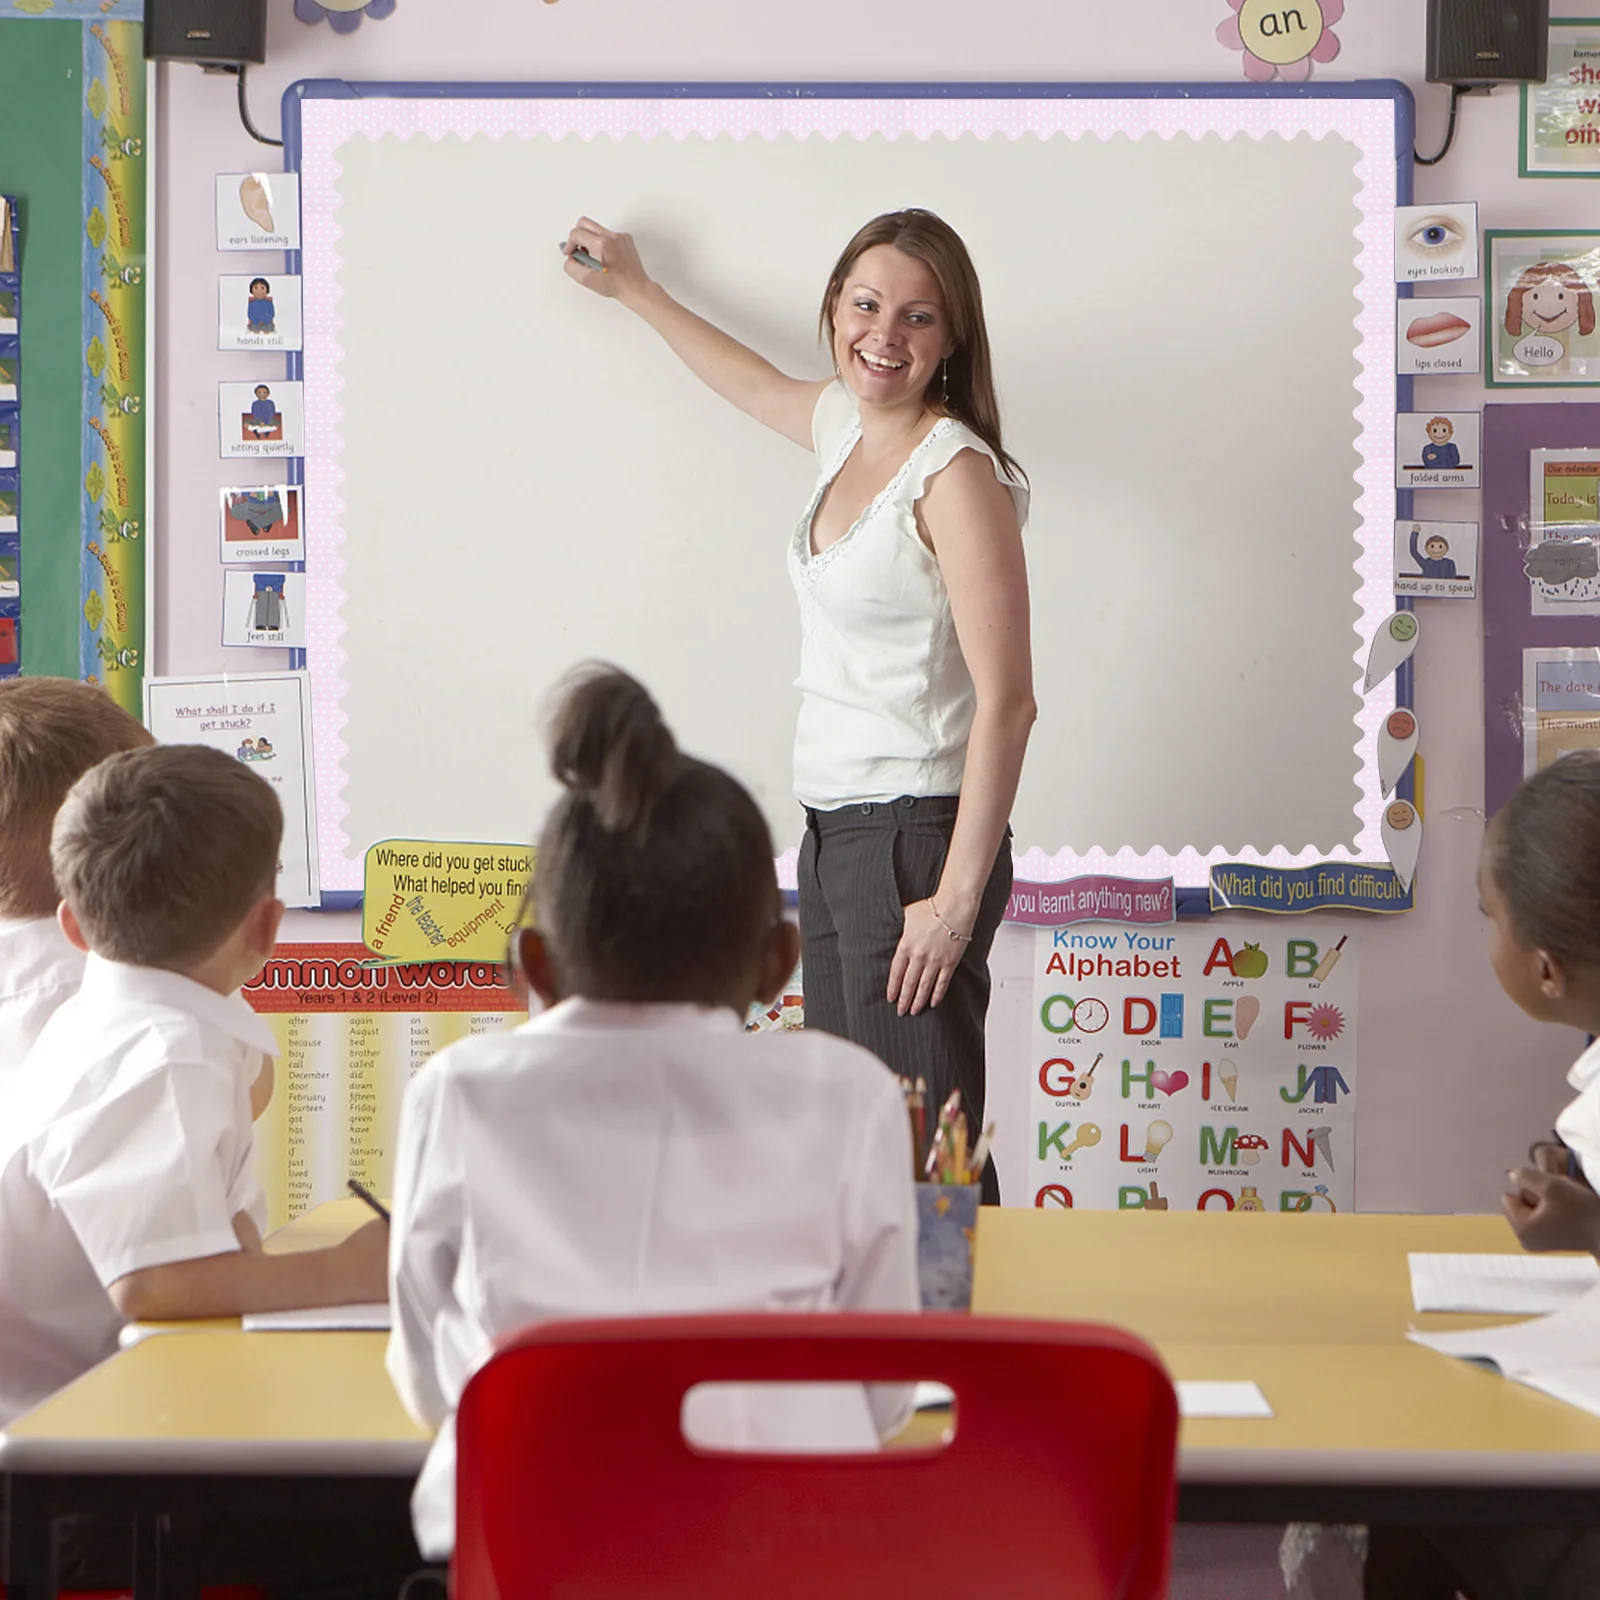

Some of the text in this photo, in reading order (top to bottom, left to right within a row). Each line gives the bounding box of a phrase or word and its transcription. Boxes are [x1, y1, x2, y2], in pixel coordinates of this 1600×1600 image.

[1260, 9, 1307, 37] an
[251, 235, 289, 247] listening
[1407, 265, 1465, 279] eyes looking
[237, 336, 284, 346] hands still
[1524, 346, 1554, 358] Hello
[1415, 358, 1463, 370] lips closed
[231, 441, 295, 456] sitting quietly
[1409, 473, 1440, 486] folded
[1546, 492, 1596, 509] Today is
[236, 546, 290, 559] crossed legs
[1394, 581, 1474, 595] hand up to speak
[246, 631, 284, 644] feet still
[1539, 680, 1593, 693] The date
[175, 702, 276, 717] What shall I do if I
[199, 718, 252, 732] get stuck?
[376, 849, 419, 868] Where
[422, 851, 442, 869] did
[446, 855, 470, 874] you
[473, 855, 495, 875] get
[393, 874, 428, 893] What
[431, 876, 476, 898] helped
[478, 881, 503, 899] you
[1216, 872, 1257, 897] What
[1260, 874, 1283, 899] did
[1286, 878, 1314, 906] you
[1317, 872, 1345, 896] find
[1349, 873, 1409, 900] difficult
[1012, 886, 1170, 917] you learnt anything new?
[371, 893, 405, 950] a friend
[405, 894, 447, 948] the teacher
[446, 898, 506, 948] equipment
[1053, 930, 1176, 951] Know Your
[1203, 937, 1239, 978] A
[1286, 940, 1320, 979] B
[1045, 952, 1182, 982] Alphabet
[296, 991, 335, 1005] Years
[340, 991, 346, 1004] 1
[352, 991, 362, 1004] &
[366, 991, 375, 1004] 2
[380, 991, 421, 1006] (Level
[425, 991, 438, 1005] 2)
[1040, 994, 1076, 1034] C
[1123, 997, 1157, 1035] D
[1203, 999, 1234, 1038] E
[288, 1016, 308, 1027] after
[349, 1017, 374, 1028] again
[470, 1016, 504, 1025] another
[1284, 1001, 1313, 1040] F
[288, 1029, 298, 1037] as
[349, 1027, 380, 1038] August
[410, 1027, 431, 1036] back
[288, 1039, 322, 1047] because
[349, 1038, 366, 1047] bed
[410, 1038, 431, 1046] been
[1141, 1039, 1162, 1047] DOOR
[288, 1050, 305, 1059] boy
[349, 1049, 381, 1058] brother
[288, 1060, 304, 1069] call
[349, 1059, 375, 1069] called
[288, 1071, 330, 1079] December
[349, 1070, 364, 1079] did
[1039, 1058, 1076, 1098] G
[1121, 1059, 1155, 1100] H
[288, 1082, 309, 1091] door
[349, 1081, 374, 1090] down
[1279, 1064, 1307, 1104] J
[288, 1092, 326, 1102] February
[349, 1091, 376, 1103] fifteen
[288, 1103, 324, 1114] fourteen
[349, 1103, 376, 1114] Friday
[288, 1116, 303, 1125] got
[349, 1116, 374, 1125] green
[288, 1126, 304, 1134] has
[349, 1126, 370, 1134] have
[288, 1137, 305, 1145] him
[349, 1136, 362, 1145] his
[1038, 1121, 1072, 1161] K
[1120, 1123, 1147, 1163] L
[1200, 1125, 1239, 1166] M
[288, 1147, 296, 1157] if
[349, 1147, 384, 1157] January
[1281, 1127, 1316, 1168] N
[288, 1159, 304, 1169] just
[349, 1158, 366, 1168] last
[288, 1169, 309, 1178] lived
[349, 1169, 367, 1178] love
[288, 1181, 313, 1190] many
[288, 1191, 310, 1200] more
[288, 1202, 307, 1210] next
